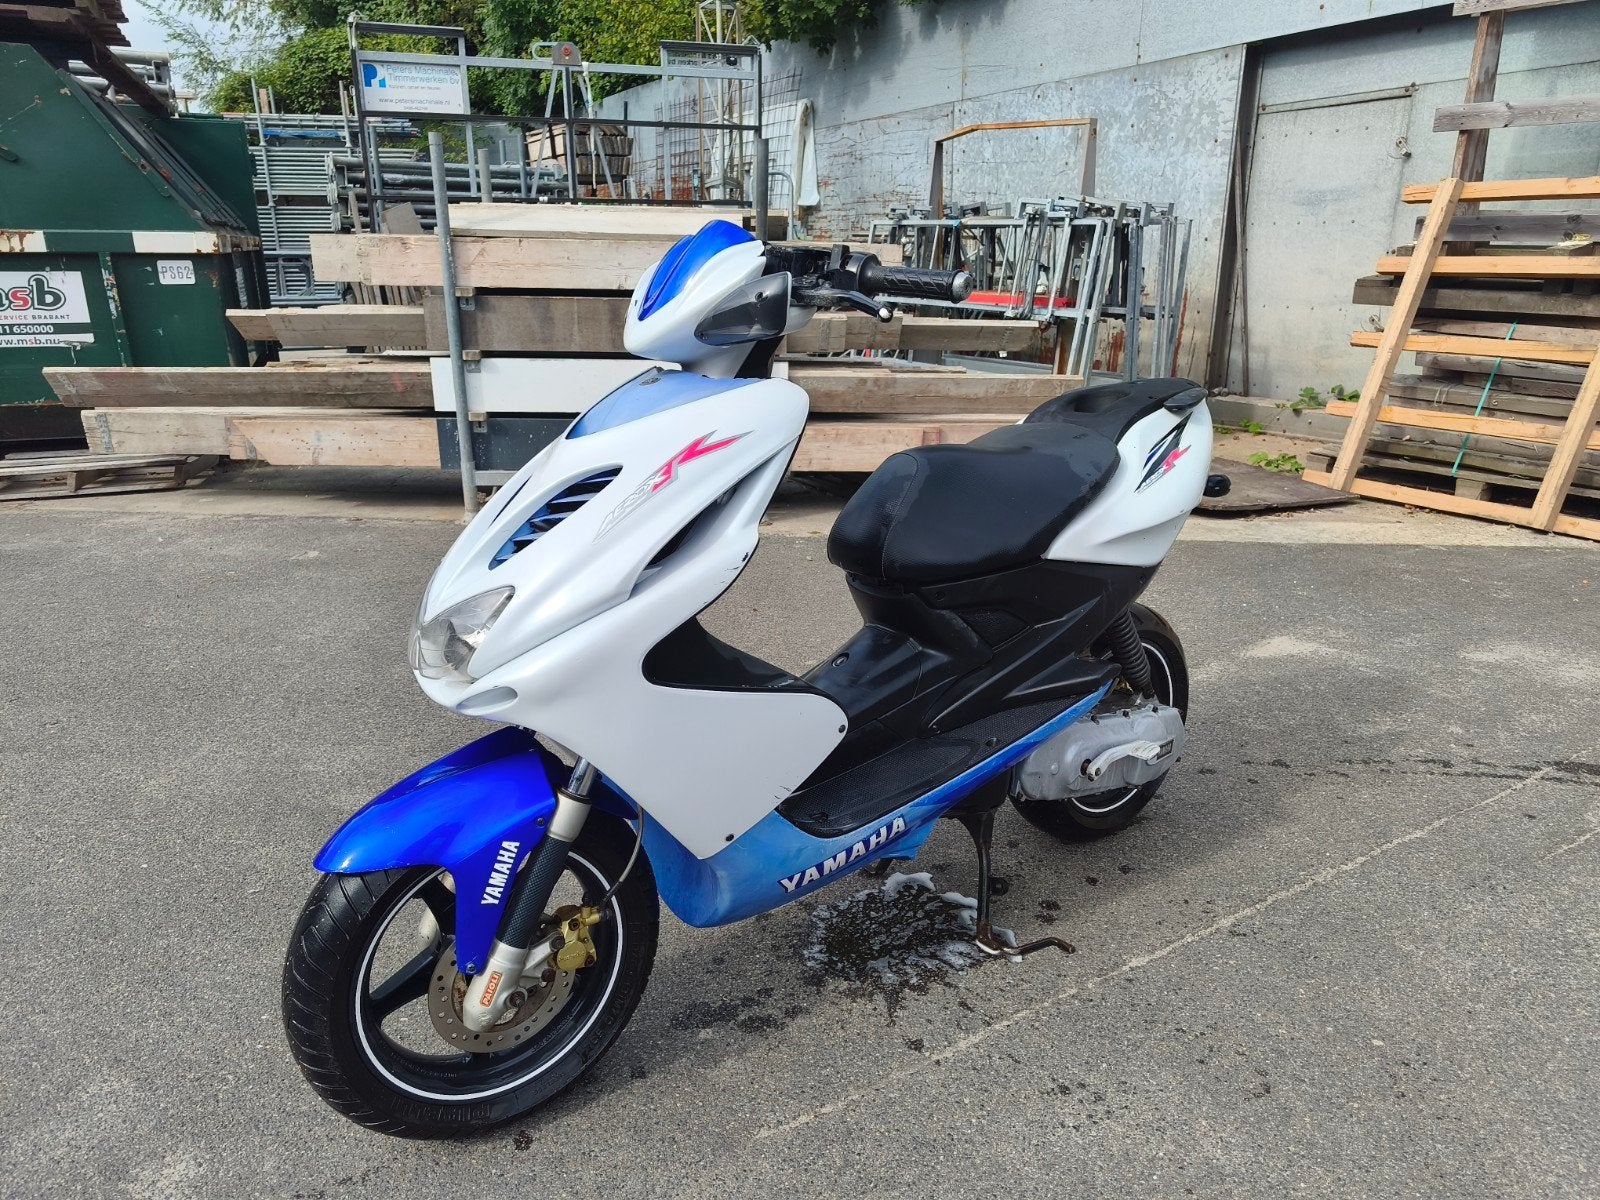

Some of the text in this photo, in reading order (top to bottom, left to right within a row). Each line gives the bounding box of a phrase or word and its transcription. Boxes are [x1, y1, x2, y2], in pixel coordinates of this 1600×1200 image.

[386, 65, 456, 76] Peters Machinale
[388, 74, 460, 85] Timmerwerken bv
[161, 265, 192, 280] PS62
[13, 325, 54, 333] 650000
[0, 336, 60, 345] w.msb.nu
[779, 815, 906, 893] YAMAHA
[480, 840, 520, 905] YAMAHA
[482, 972, 501, 1006] PAIOLI
